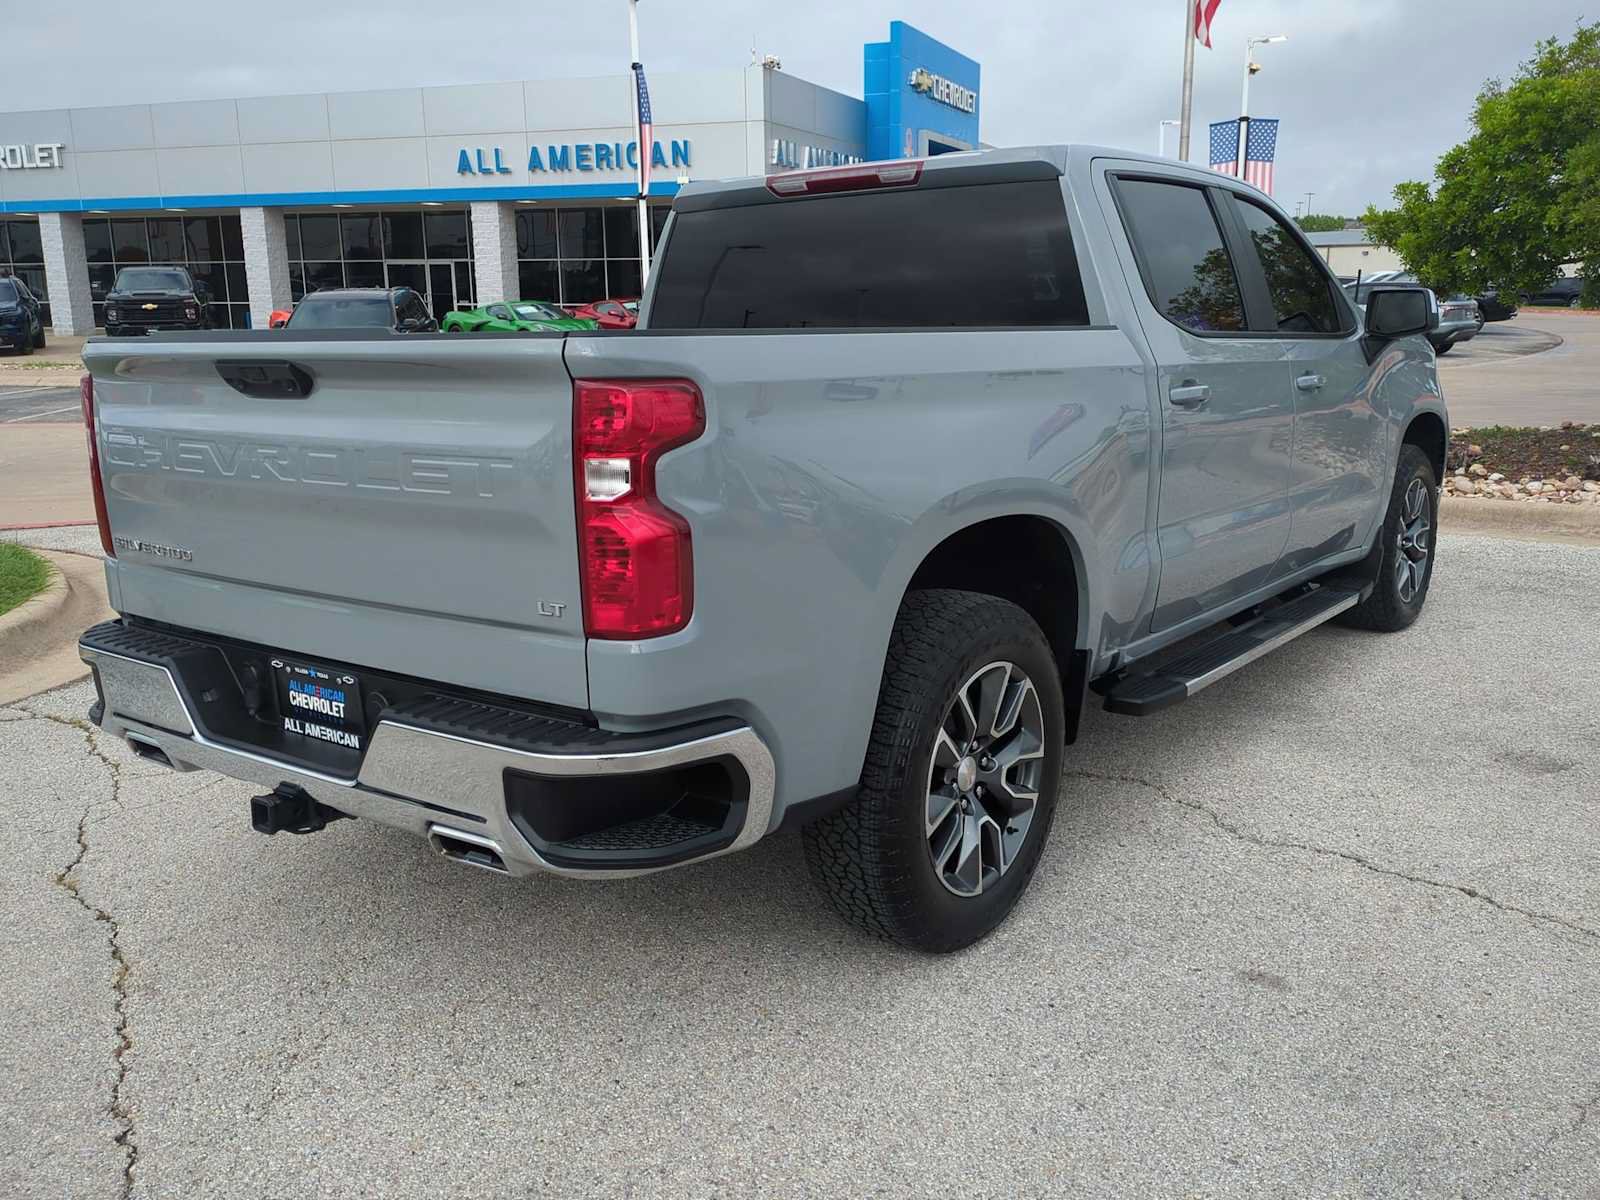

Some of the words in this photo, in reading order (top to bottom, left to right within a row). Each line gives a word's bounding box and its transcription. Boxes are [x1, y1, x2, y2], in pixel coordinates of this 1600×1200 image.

[932, 74, 977, 112] CHEVROLET
[457, 148, 512, 176] ALL
[528, 139, 692, 173] AMERICAN
[105, 431, 513, 498] CHEVROLET
[536, 601, 567, 618] LT
[289, 679, 303, 692] ALL
[304, 683, 345, 702] AMERICAN
[289, 690, 345, 718] CHEVROLET
[284, 717, 304, 734] ALL
[305, 723, 360, 749] AMERICAN
